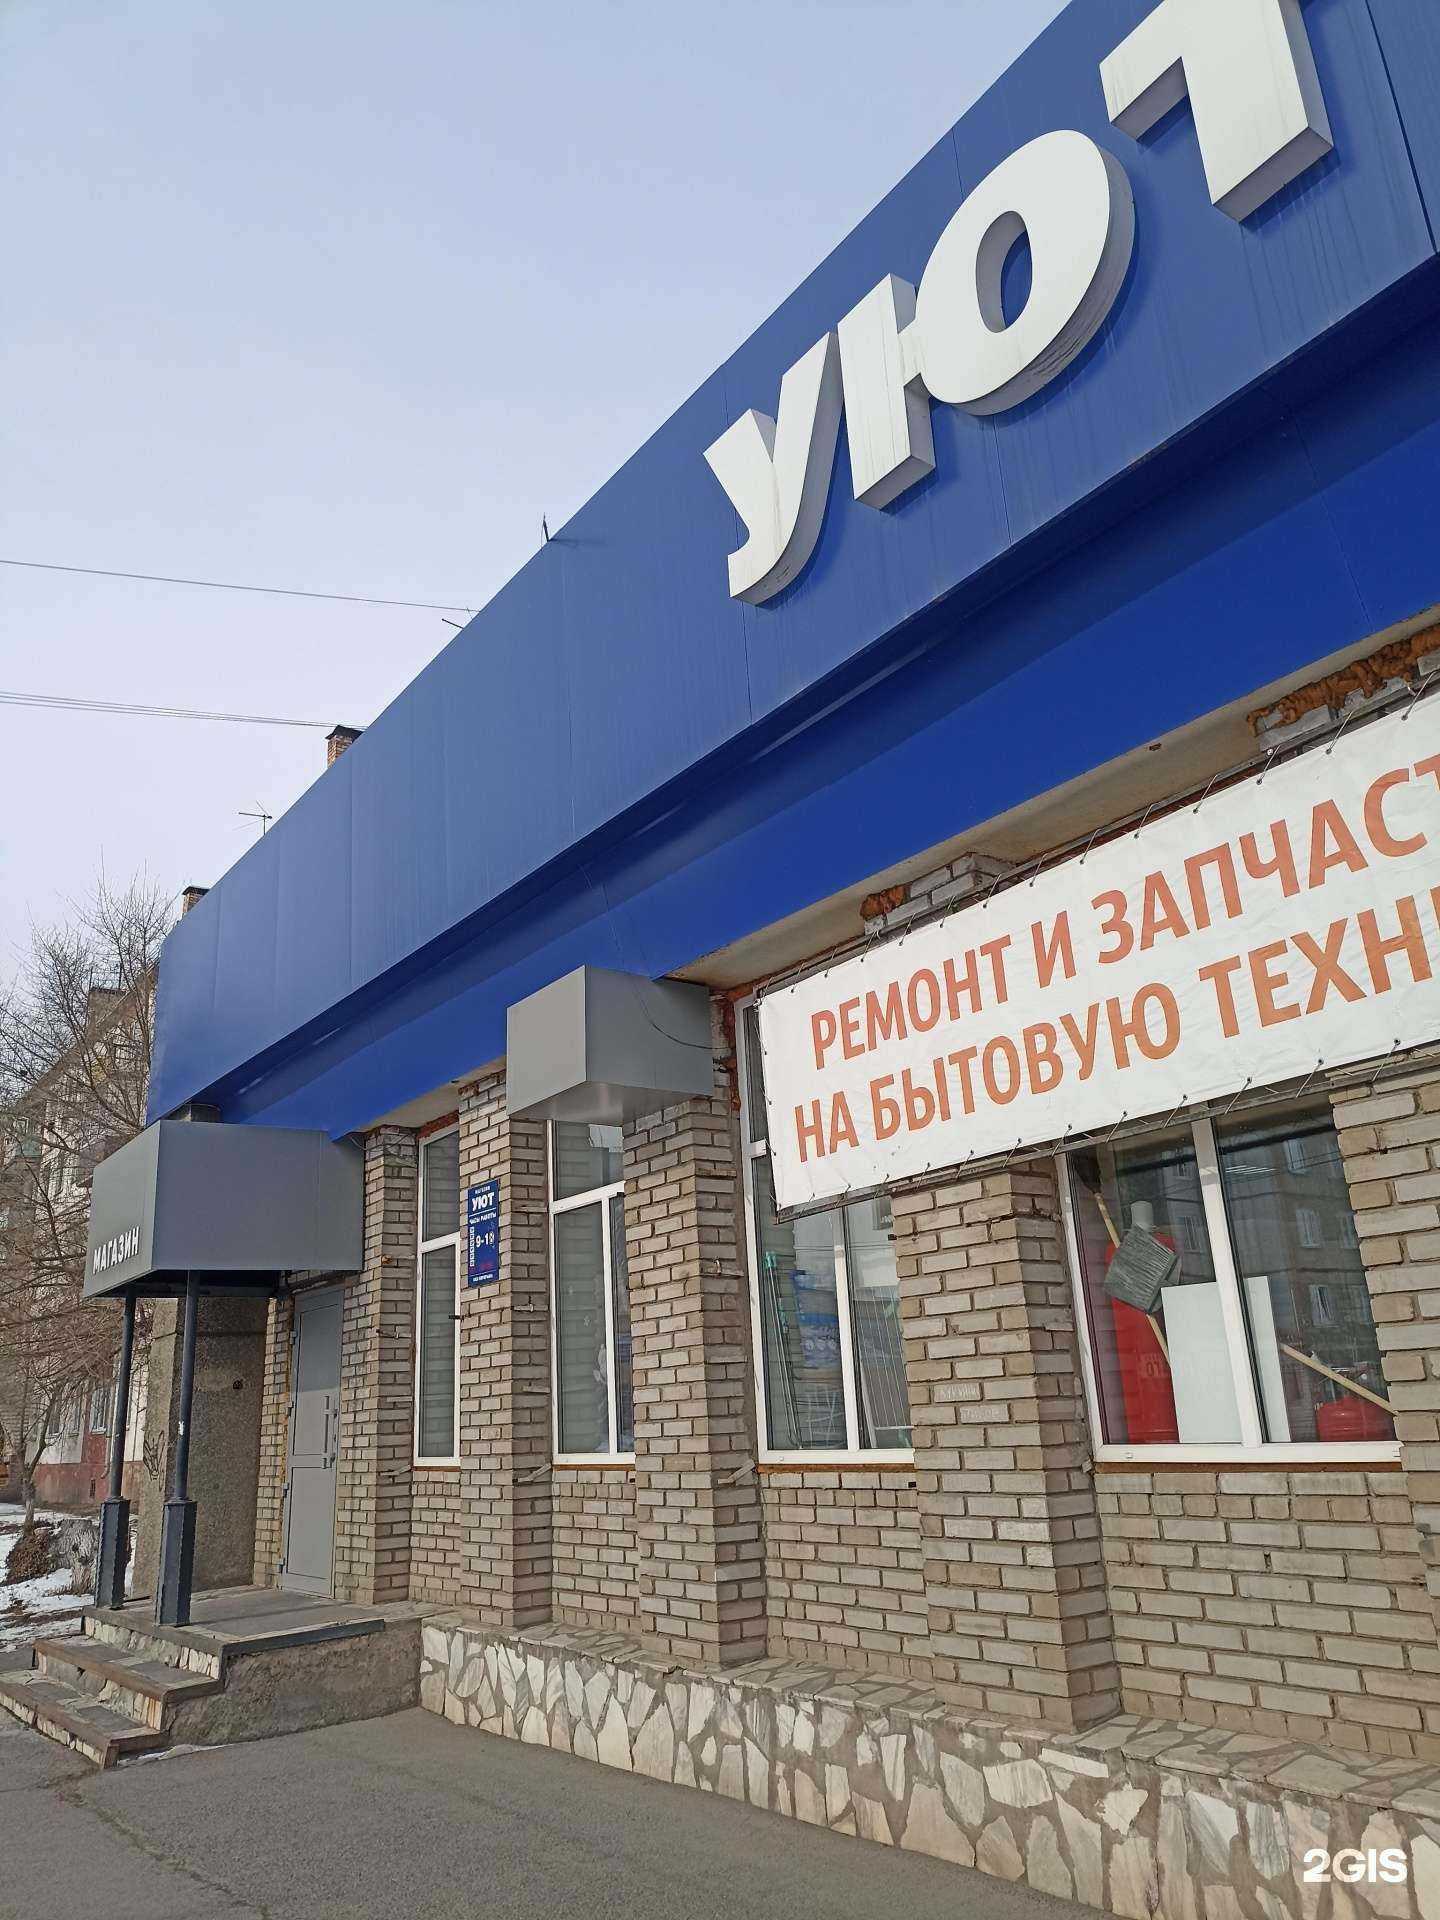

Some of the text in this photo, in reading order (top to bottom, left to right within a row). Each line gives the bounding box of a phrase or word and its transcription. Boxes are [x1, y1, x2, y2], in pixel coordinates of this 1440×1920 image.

[793, 885, 1440, 1163] НА БЫТОВУЮ ТЕХН
[810, 934, 1012, 1070] РЕМОНТ
[1030, 911, 1077, 989] И
[92, 1226, 140, 1275] МАГАЗИН
[471, 1192, 495, 1212] УЮТ
